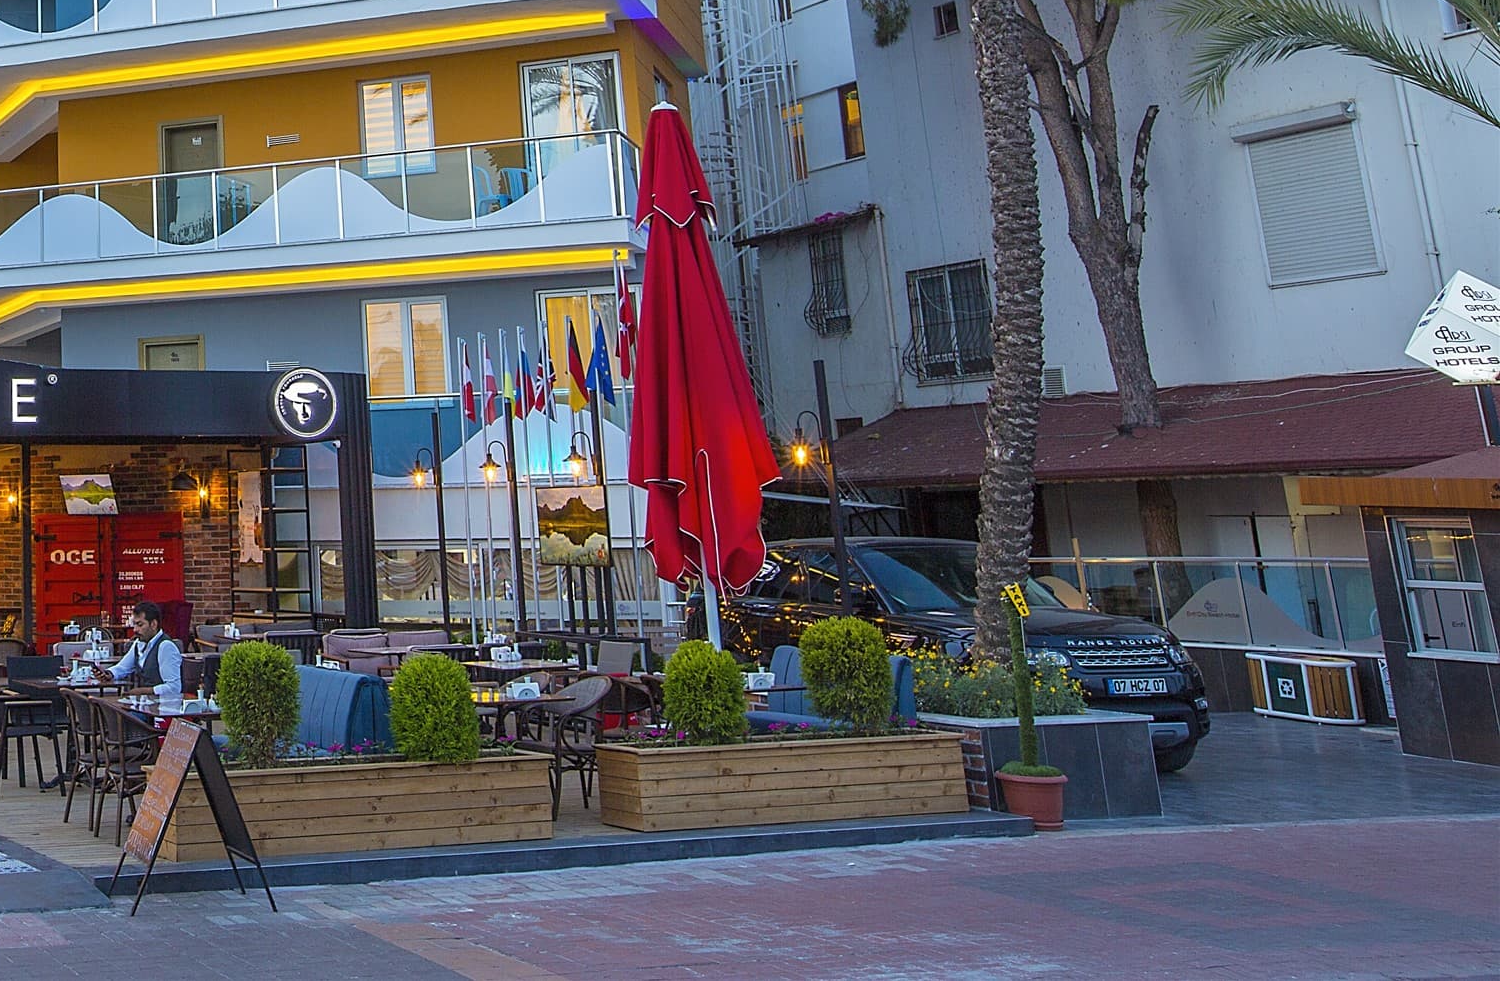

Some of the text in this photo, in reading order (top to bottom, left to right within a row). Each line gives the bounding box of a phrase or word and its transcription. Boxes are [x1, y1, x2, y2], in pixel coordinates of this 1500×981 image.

[1432, 344, 1491, 355] GROUP
[1435, 356, 1500, 367] HOTELS
[50, 549, 96, 565] OCE
[1113, 679, 1166, 692] 07 HCZ 07
